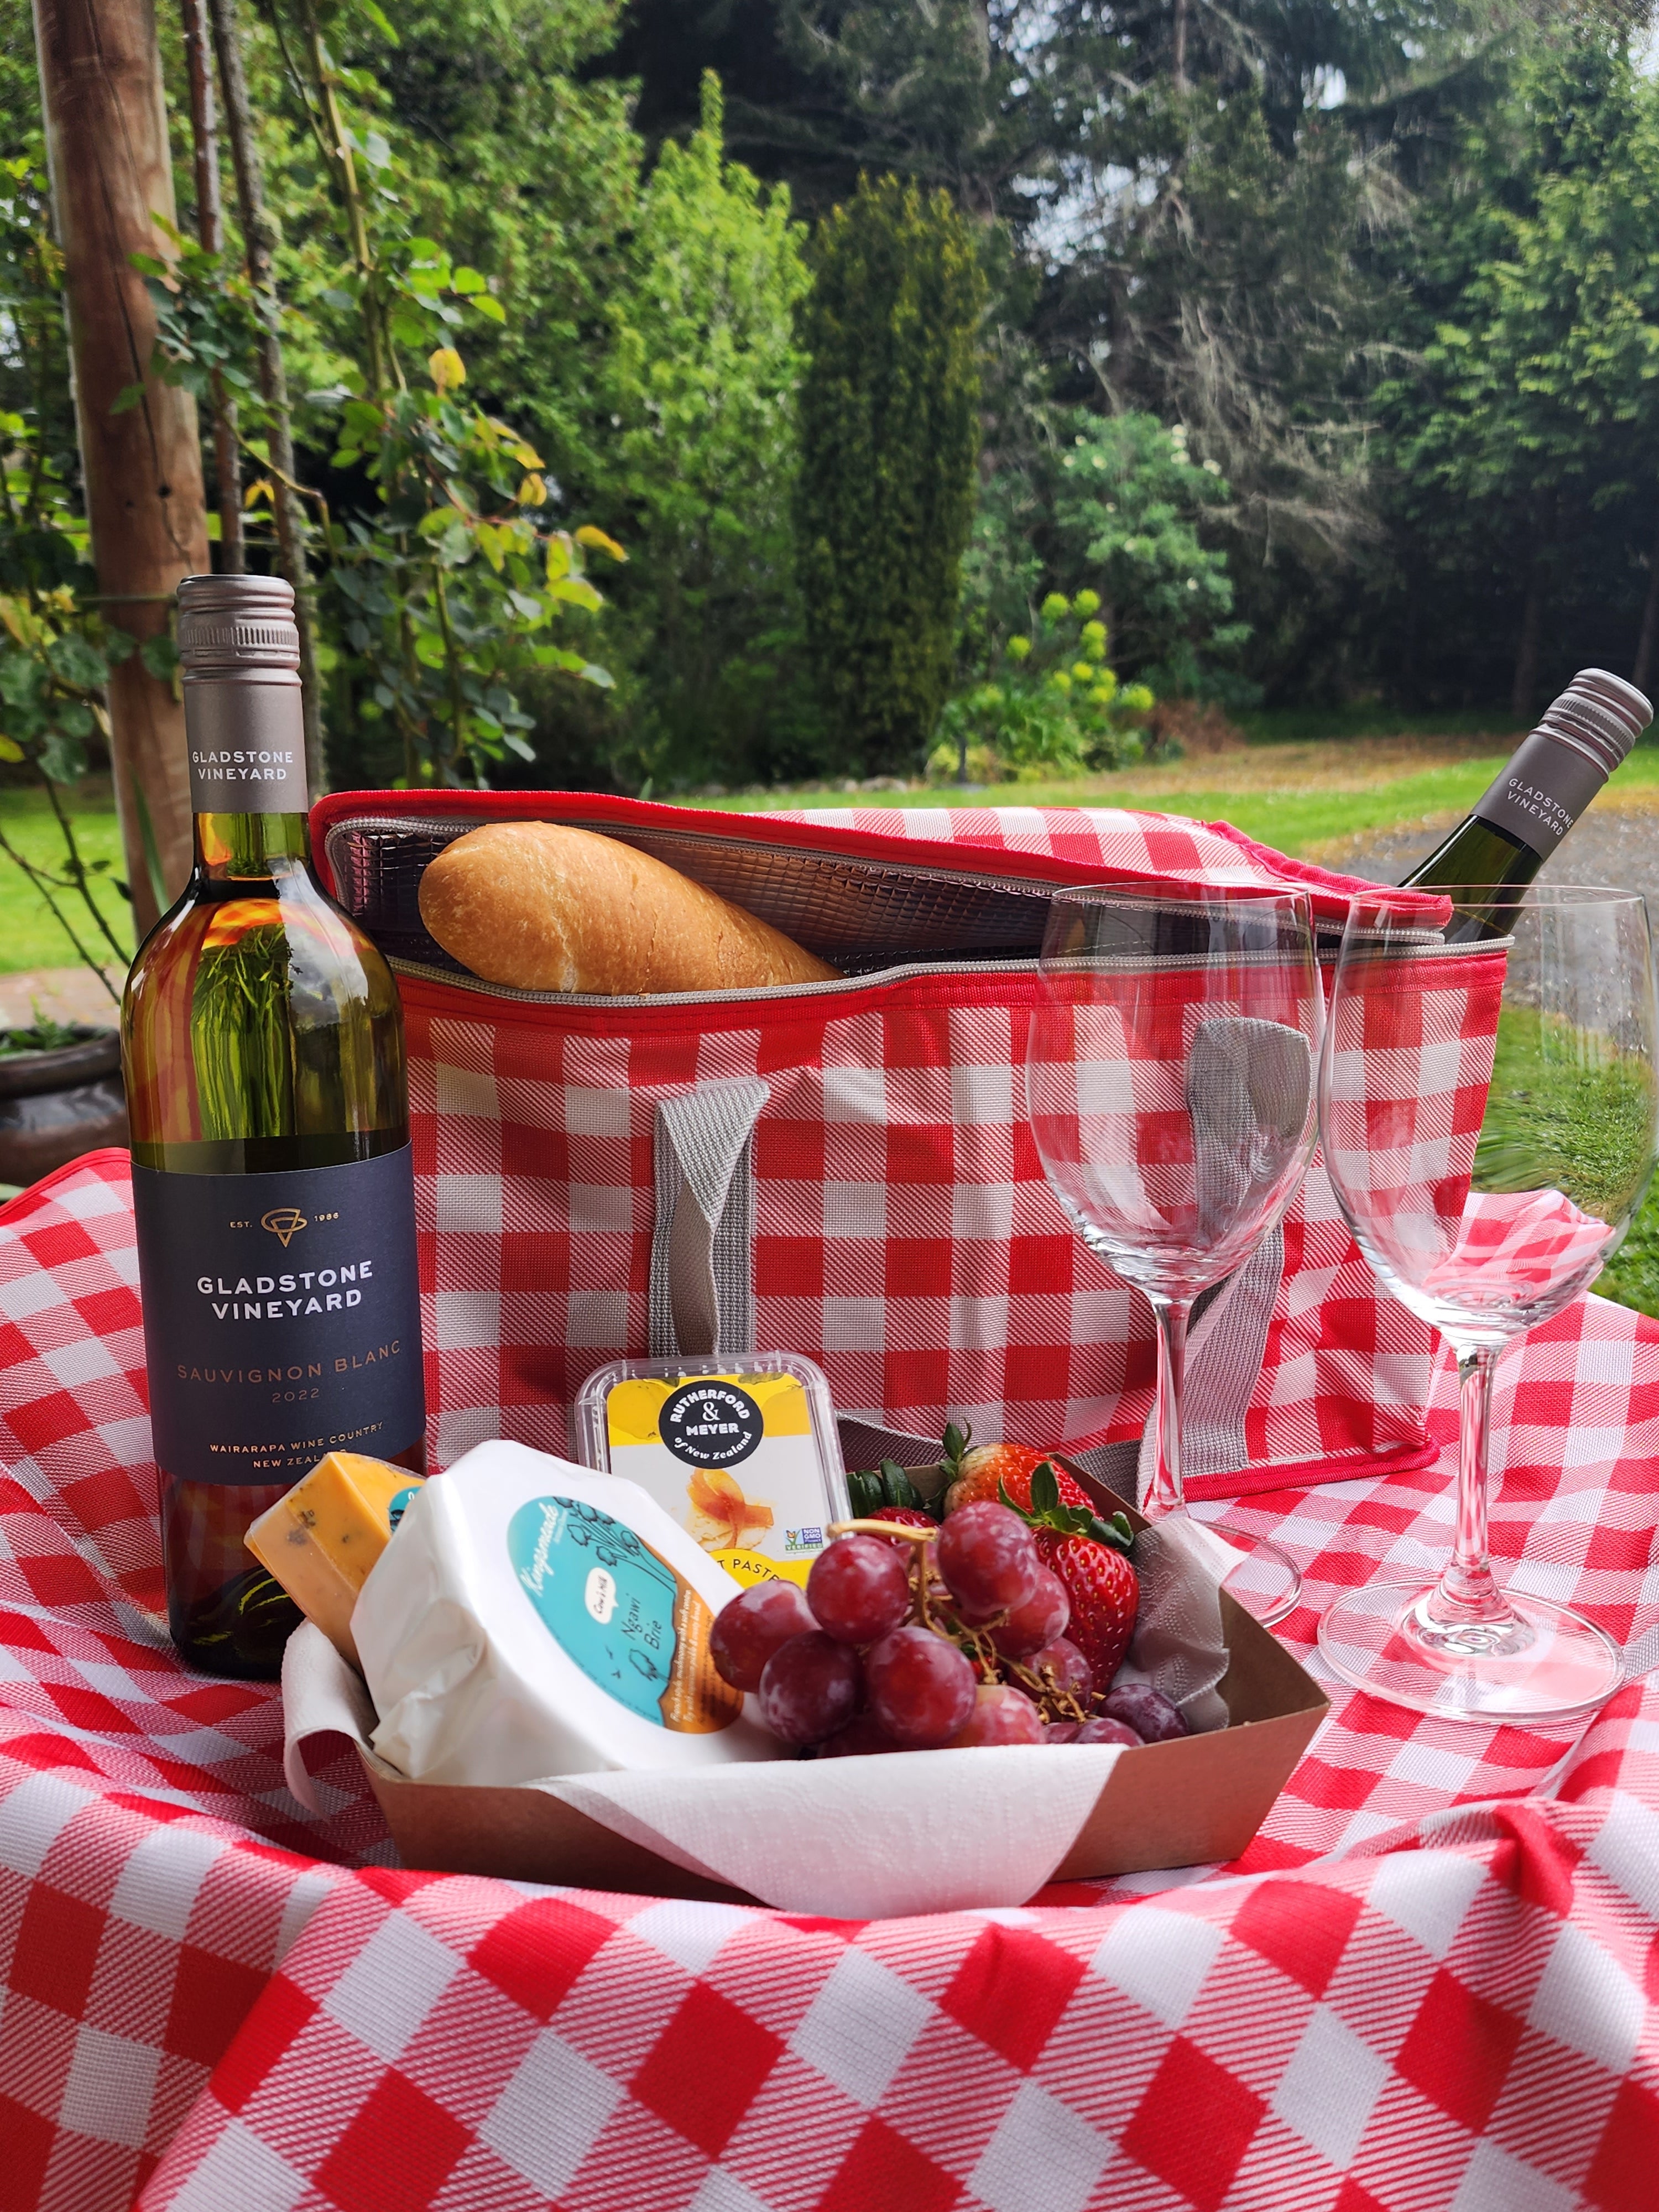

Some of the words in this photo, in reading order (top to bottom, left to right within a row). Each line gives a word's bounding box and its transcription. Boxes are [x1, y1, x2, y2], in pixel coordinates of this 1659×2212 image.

[192, 751, 293, 763] GLADSTONE
[197, 768, 287, 780] VINEYARD
[1507, 791, 1563, 836] VINEYARD
[1509, 778, 1574, 828] GLADSTONE
[314, 1212, 339, 1222] 1986
[197, 1260, 373, 1295] GLADSTONE
[211, 1288, 362, 1320] VINEYARD
[178, 1363, 322, 1383] SAUVIGNON
[335, 1340, 401, 1373] BLANC
[272, 1387, 320, 1404] 2022
[670, 1389, 750, 1423] RUTHERFORD
[702, 1402, 721, 1421] &
[210, 1444, 286, 1453] WAIRARAPA
[291, 1438, 325, 1451] WINE
[329, 1421, 383, 1444] COUNTRY
[686, 1423, 739, 1436] MEYER
[253, 1459, 282, 1468] NEW
[287, 1449, 347, 1466] ZEAL
[674, 1437, 688, 1448] of
[685, 1446, 709, 1459] New
[712, 1431, 753, 1460] Zealand
[620, 1593, 643, 1640] Ngawi
[644, 1620, 662, 1650] Brie
